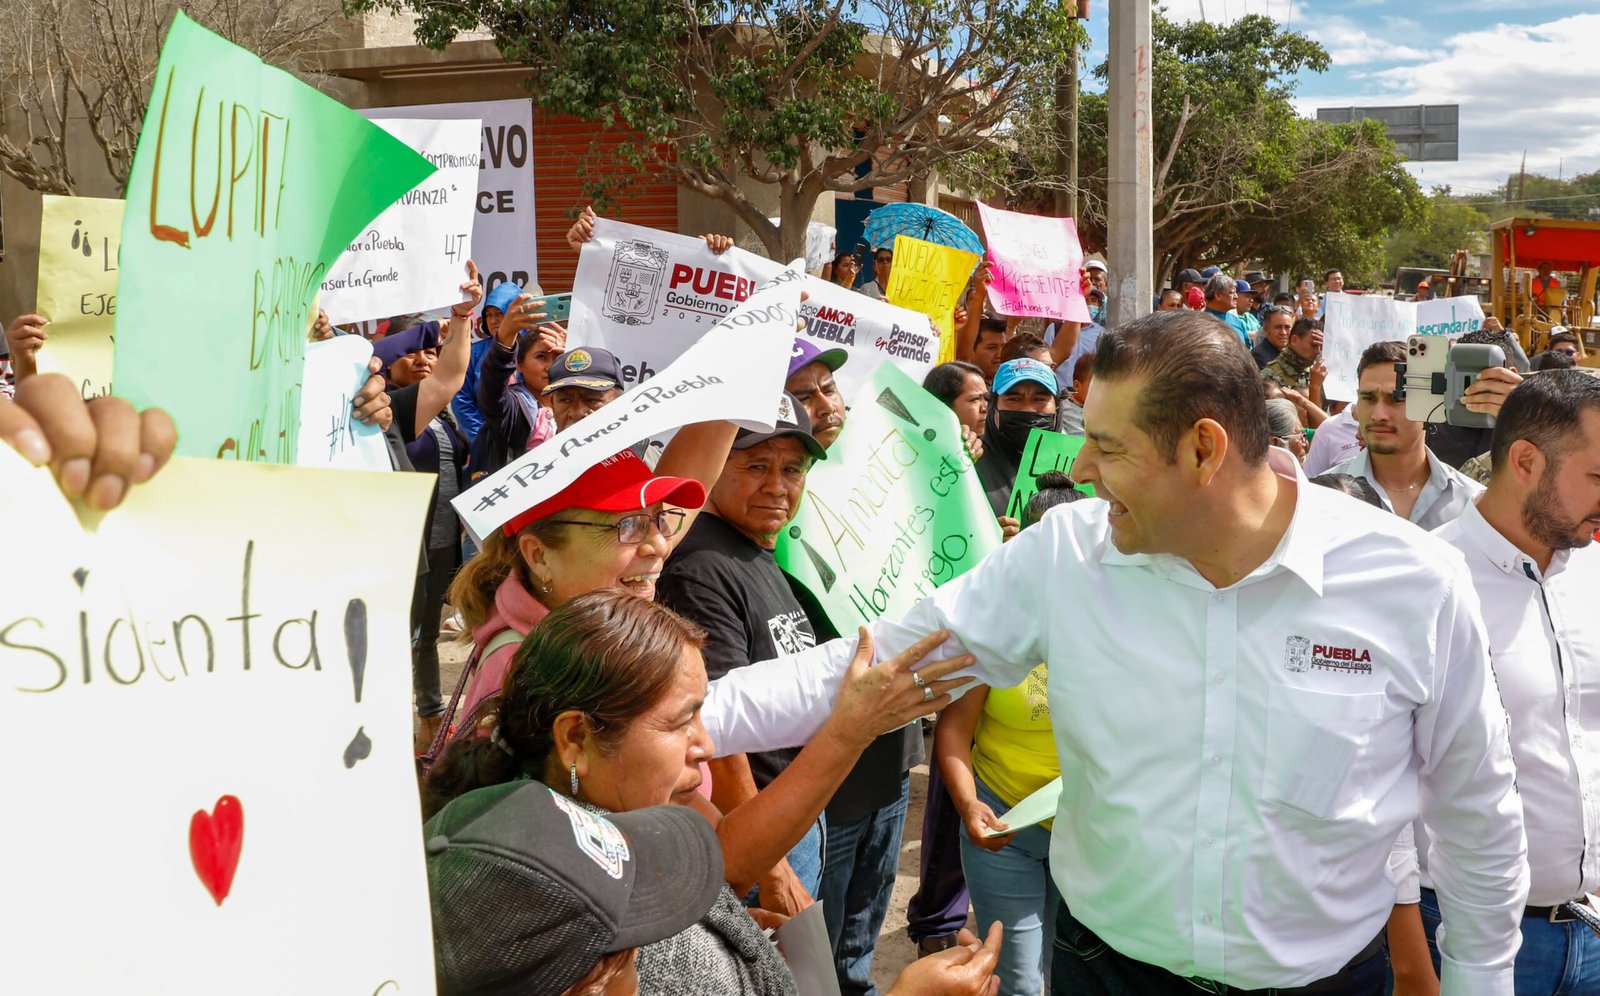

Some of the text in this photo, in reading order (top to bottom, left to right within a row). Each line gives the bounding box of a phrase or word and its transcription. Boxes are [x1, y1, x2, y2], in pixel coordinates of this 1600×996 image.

[666, 291, 728, 314] Gobierno
[816, 306, 855, 328] AMOR
[889, 323, 930, 348] Pensar
[885, 341, 932, 364] Grande
[600, 455, 619, 469] NEW
[1312, 644, 1371, 662] PUEBLA
